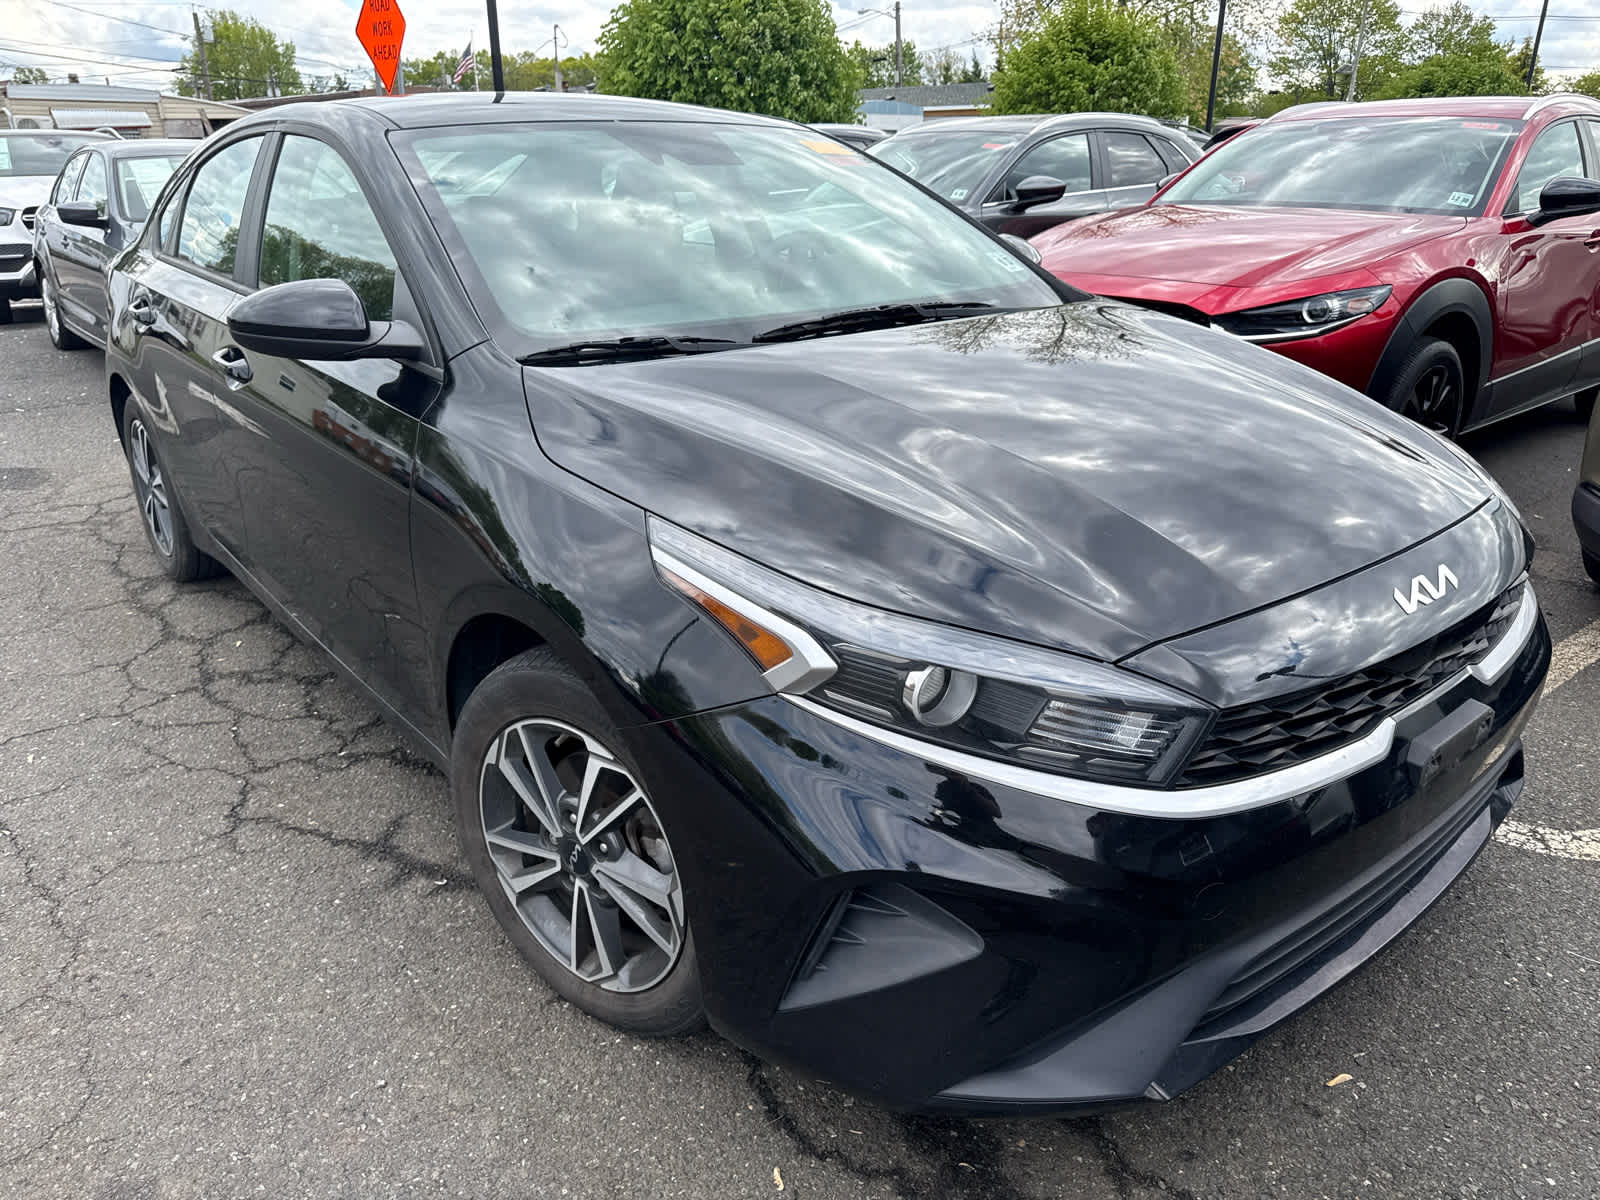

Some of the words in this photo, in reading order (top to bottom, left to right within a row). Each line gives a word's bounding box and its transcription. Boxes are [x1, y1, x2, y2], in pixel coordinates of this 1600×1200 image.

[369, 0, 390, 12] ROAD
[372, 20, 393, 37] WORK
[373, 44, 398, 60] AHEAD
[1393, 563, 1459, 614] KIA
